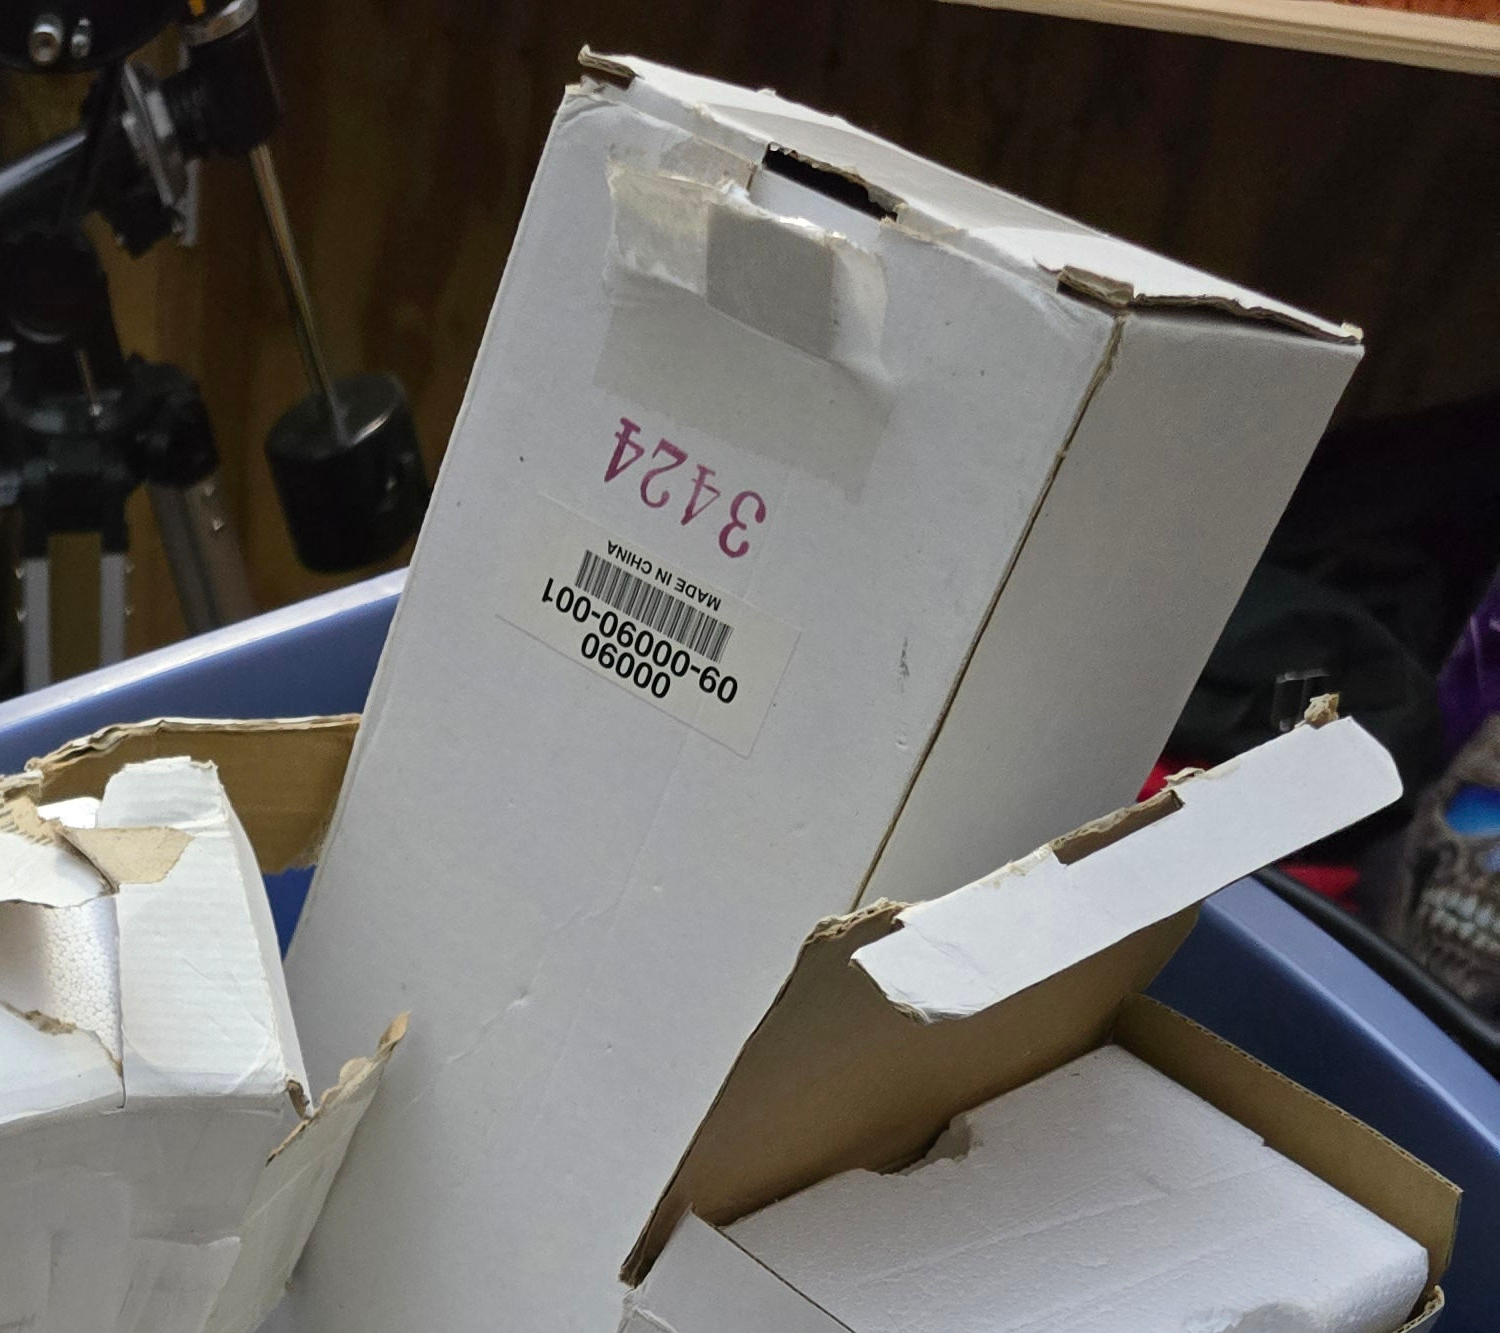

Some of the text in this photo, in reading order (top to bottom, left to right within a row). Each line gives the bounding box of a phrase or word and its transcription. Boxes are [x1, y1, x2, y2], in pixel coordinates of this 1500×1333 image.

[603, 416, 767, 559] 3424
[607, 540, 722, 612] MADE IN CHINA
[541, 577, 739, 704] 09-00090-001
[581, 632, 672, 699] 00090
